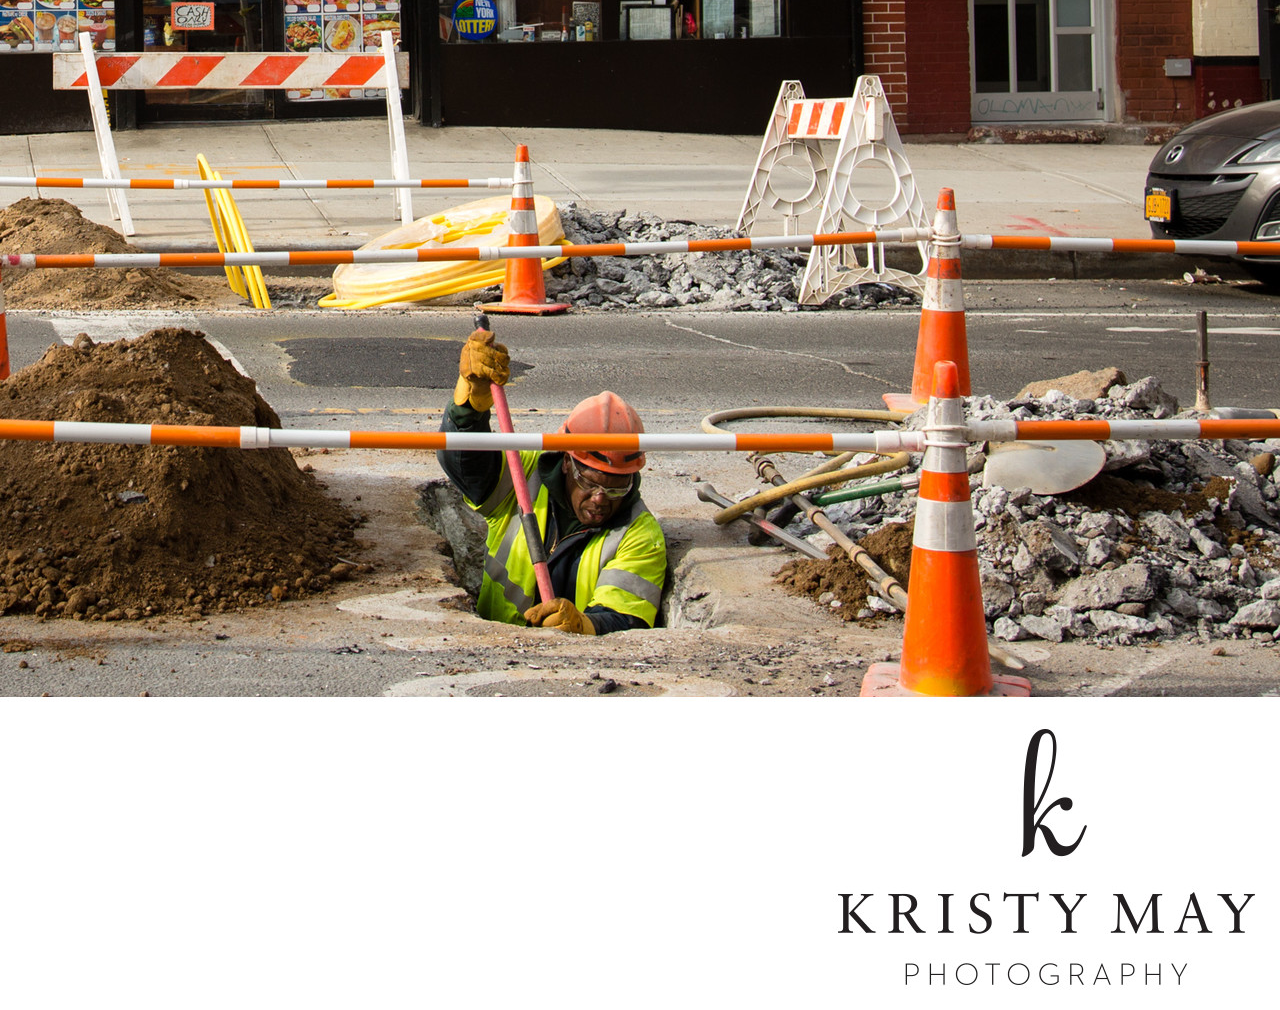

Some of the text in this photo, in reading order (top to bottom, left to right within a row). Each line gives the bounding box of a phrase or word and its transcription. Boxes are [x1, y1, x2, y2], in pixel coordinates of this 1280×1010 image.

[176, 5, 210, 16] CASH
[476, 7, 496, 19] YORK
[455, 19, 497, 35] LOTTERY
